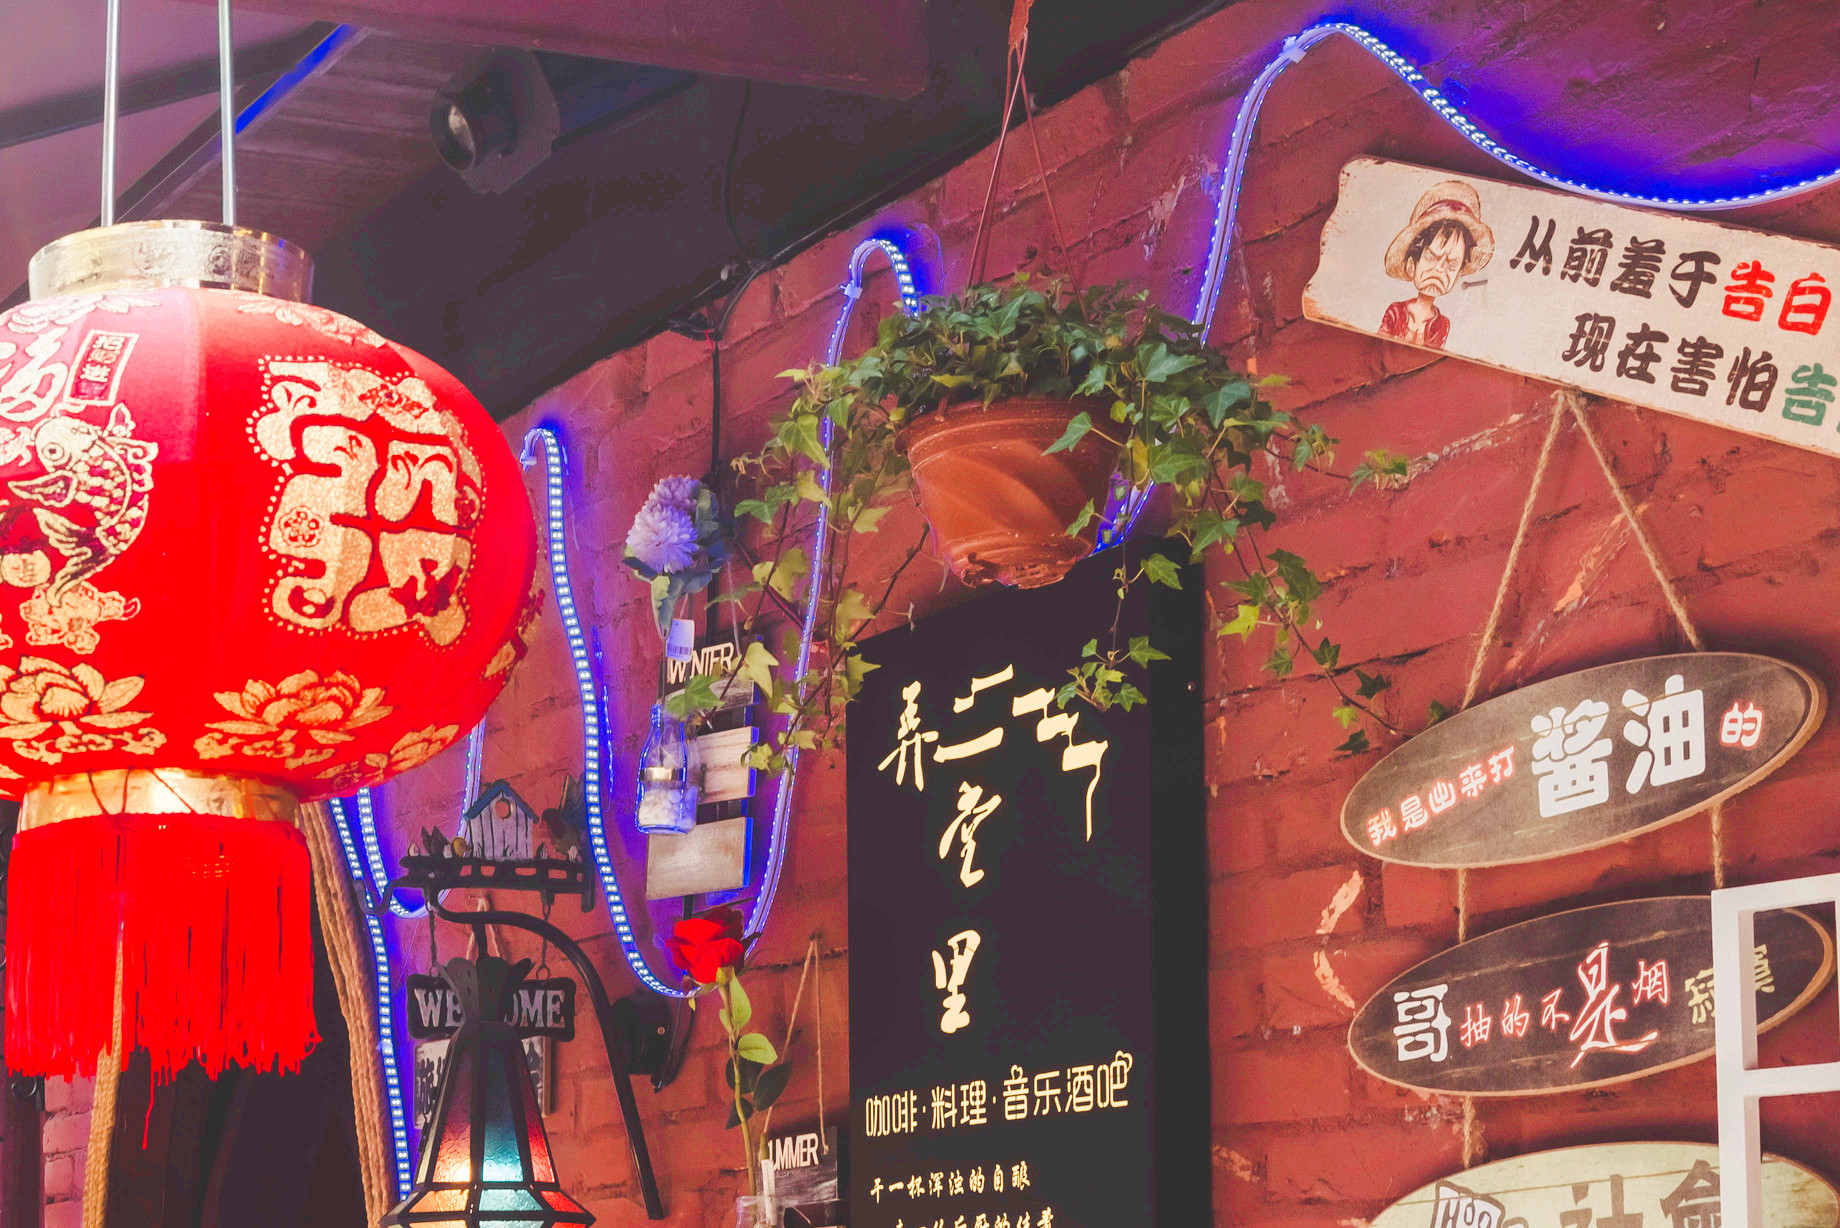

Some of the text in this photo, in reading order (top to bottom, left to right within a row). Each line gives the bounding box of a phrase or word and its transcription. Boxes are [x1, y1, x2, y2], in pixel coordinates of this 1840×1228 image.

[1510, 215, 1832, 336] 从前羞于告白
[1561, 311, 1840, 436] 现在害怕告
[667, 641, 735, 684] WNTER
[758, 1132, 820, 1172] UMMER
[870, 1160, 1031, 1204] 干一杯浑浊的自酿
